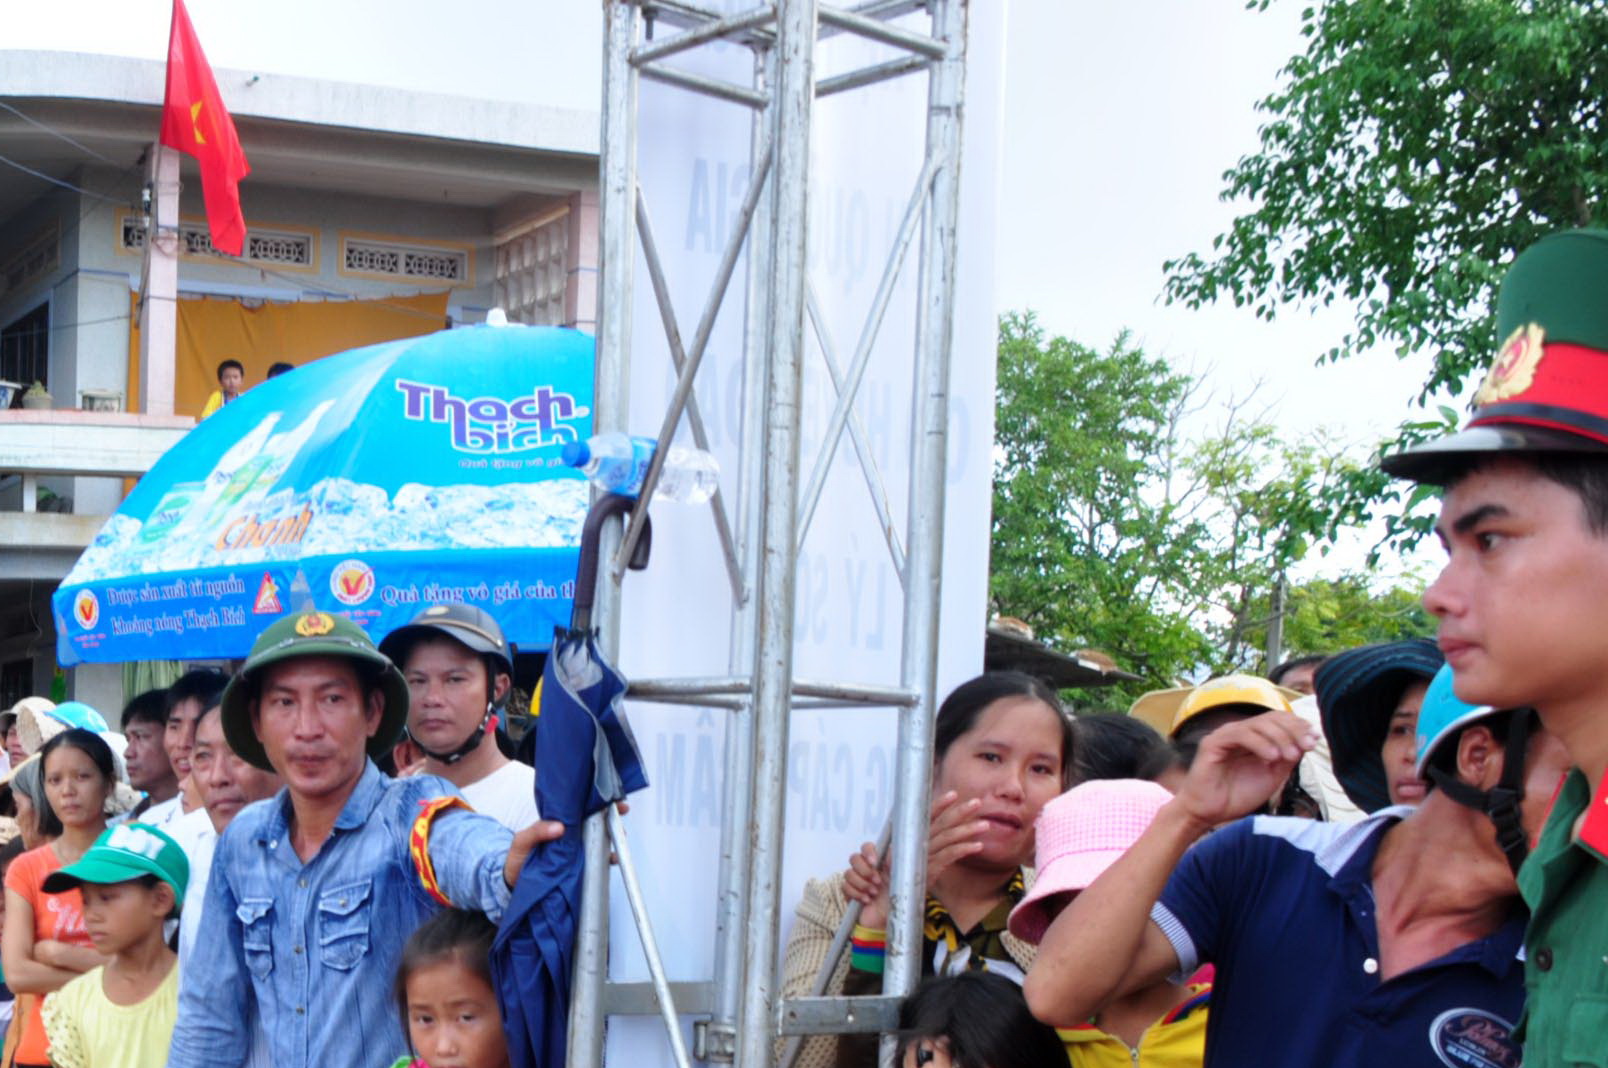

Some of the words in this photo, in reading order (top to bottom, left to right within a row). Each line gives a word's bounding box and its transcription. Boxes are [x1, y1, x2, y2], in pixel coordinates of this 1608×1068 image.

[381, 583, 420, 606] Quà
[467, 581, 490, 600] vô
[493, 580, 521, 605] giá
